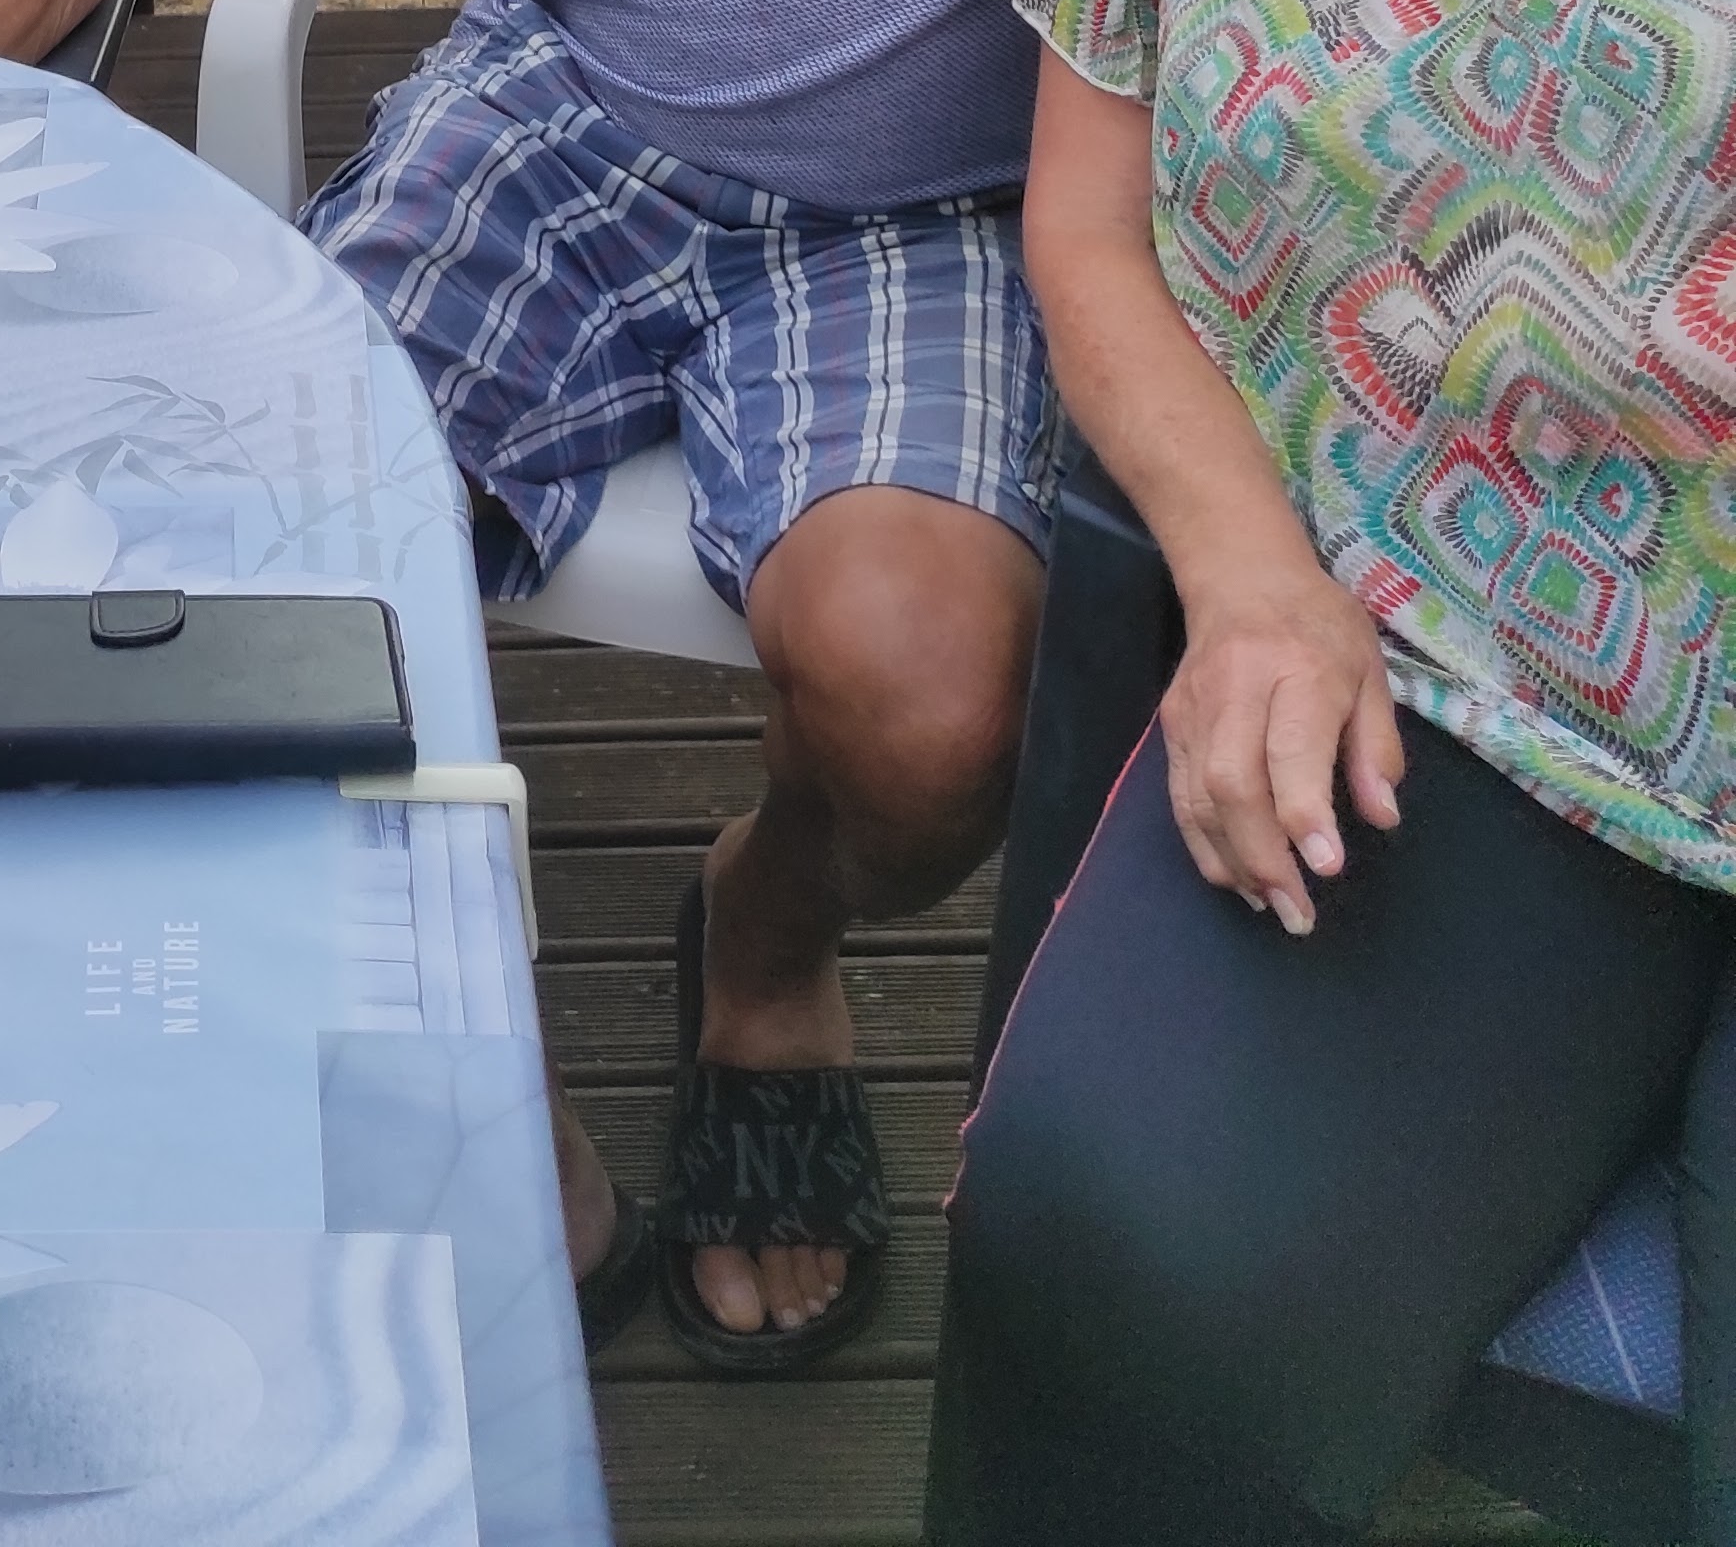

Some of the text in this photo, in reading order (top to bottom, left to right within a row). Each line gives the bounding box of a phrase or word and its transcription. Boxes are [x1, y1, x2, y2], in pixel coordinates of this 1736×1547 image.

[84, 939, 123, 1016] LIFE
[131, 957, 157, 996] AND
[162, 919, 200, 1034] NATURE
[731, 1122, 820, 1198] NY
